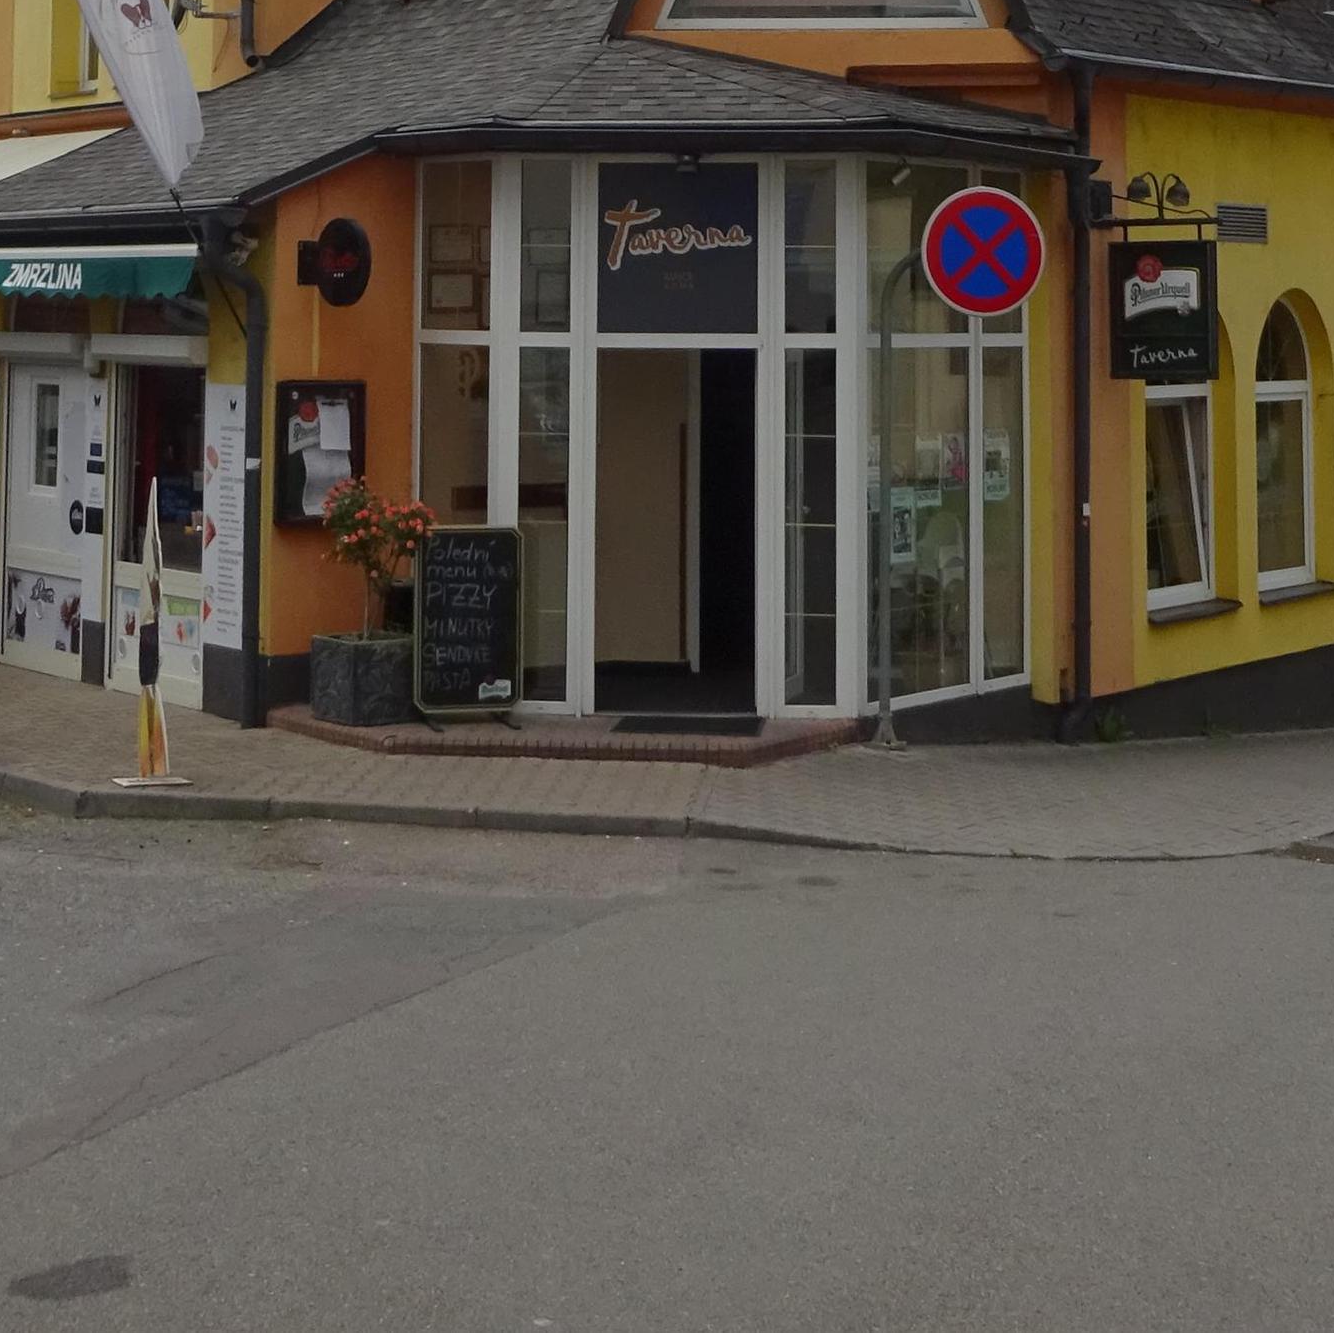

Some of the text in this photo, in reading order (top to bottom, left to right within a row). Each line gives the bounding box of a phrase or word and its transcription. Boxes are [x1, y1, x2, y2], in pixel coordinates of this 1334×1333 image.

[604, 199, 753, 271] Taverna
[1, 263, 82, 290] ZMRZLINA
[1129, 345, 1198, 369] Taverna
[426, 564, 477, 580] menu
[426, 581, 498, 610] PIZZY
